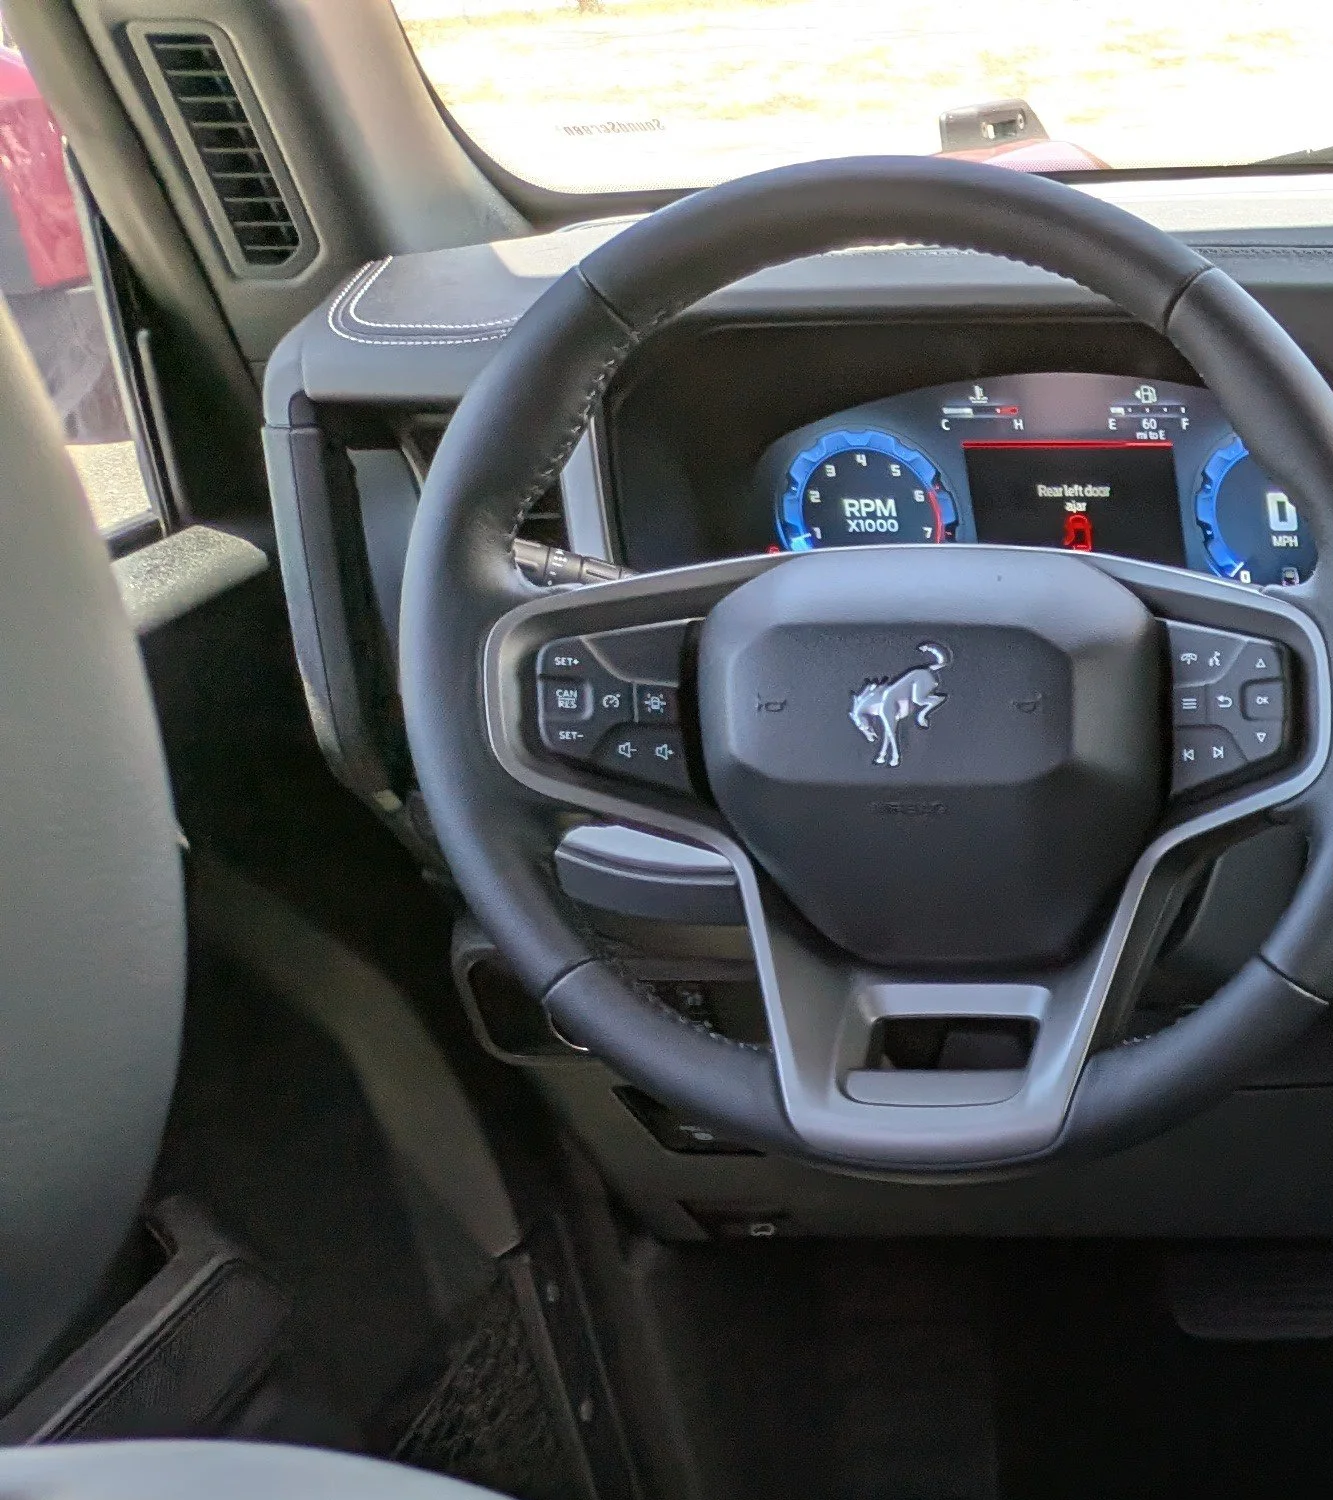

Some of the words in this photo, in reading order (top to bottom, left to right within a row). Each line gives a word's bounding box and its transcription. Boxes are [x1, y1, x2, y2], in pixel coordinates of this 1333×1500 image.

[941, 419, 951, 431] C
[1014, 419, 1024, 430] H
[1108, 418, 1117, 431] E
[1142, 418, 1158, 430] 60
[1181, 418, 1190, 430] F
[855, 454, 868, 467] 4
[825, 464, 837, 478] 3
[890, 464, 901, 477] 5
[808, 490, 821, 503] 2
[914, 490, 925, 503] 6
[1036, 484, 1063, 498] Rear
[1063, 483, 1084, 497] left
[1084, 484, 1111, 497] door
[843, 499, 898, 518] RPM
[1064, 500, 1087, 514] ajar
[1266, 492, 1298, 532] 0
[847, 519, 899, 533] X1000
[813, 527, 822, 539] 1
[922, 527, 933, 539] 7
[1271, 535, 1299, 547] MPH
[1240, 570, 1251, 584] 0
[556, 689, 578, 698] CAN
[1256, 695, 1269, 705] OK
